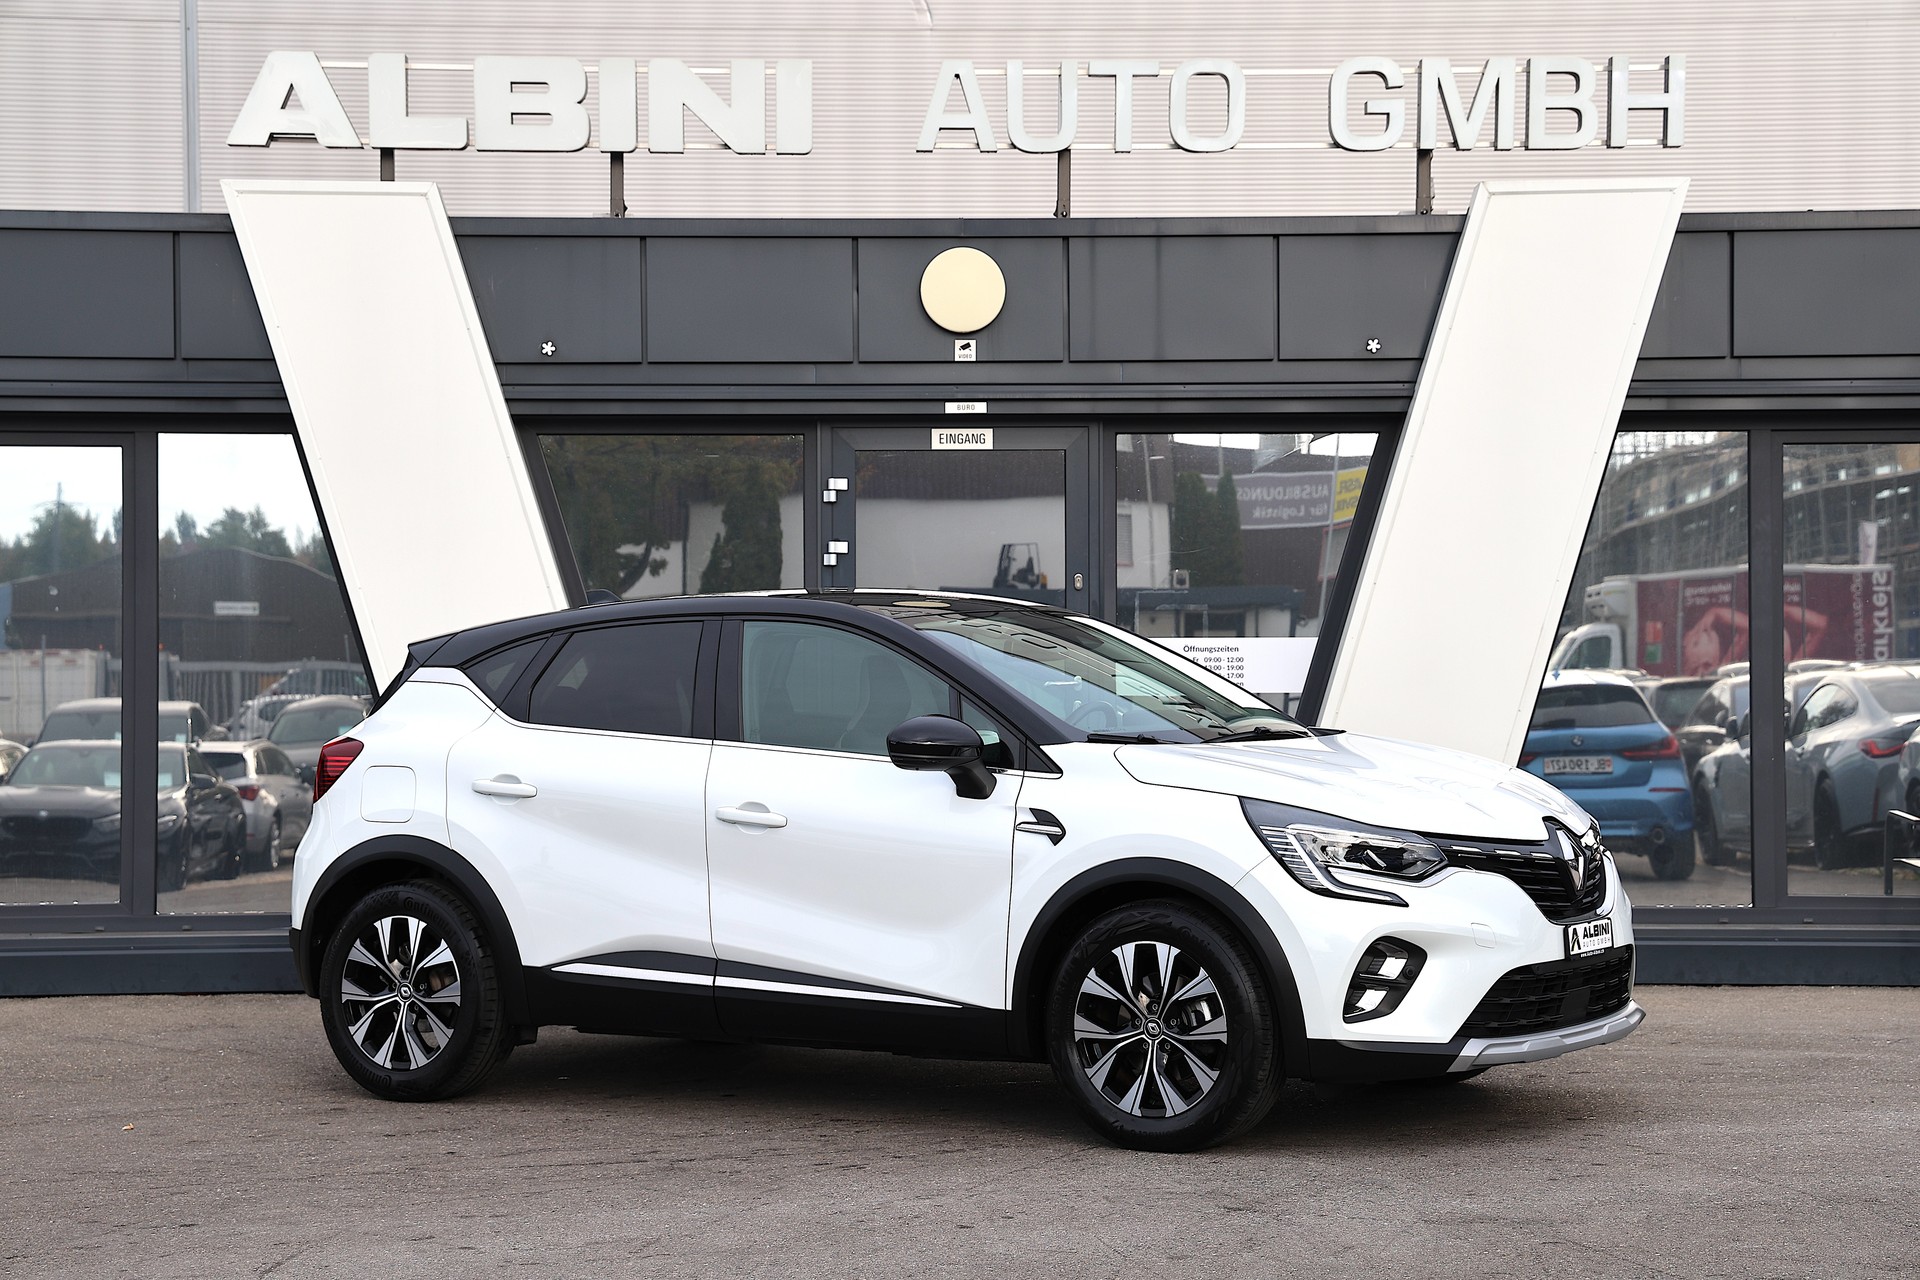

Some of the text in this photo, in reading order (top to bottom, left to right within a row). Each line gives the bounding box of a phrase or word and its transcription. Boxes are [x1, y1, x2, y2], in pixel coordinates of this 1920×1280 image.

[226, 50, 1687, 155] ALBINI AUTO GMBH
[939, 433, 986, 444] EINGANG
[1183, 645, 1239, 654] Öffnungszeiten
[1583, 922, 1610, 939] ALBINI
